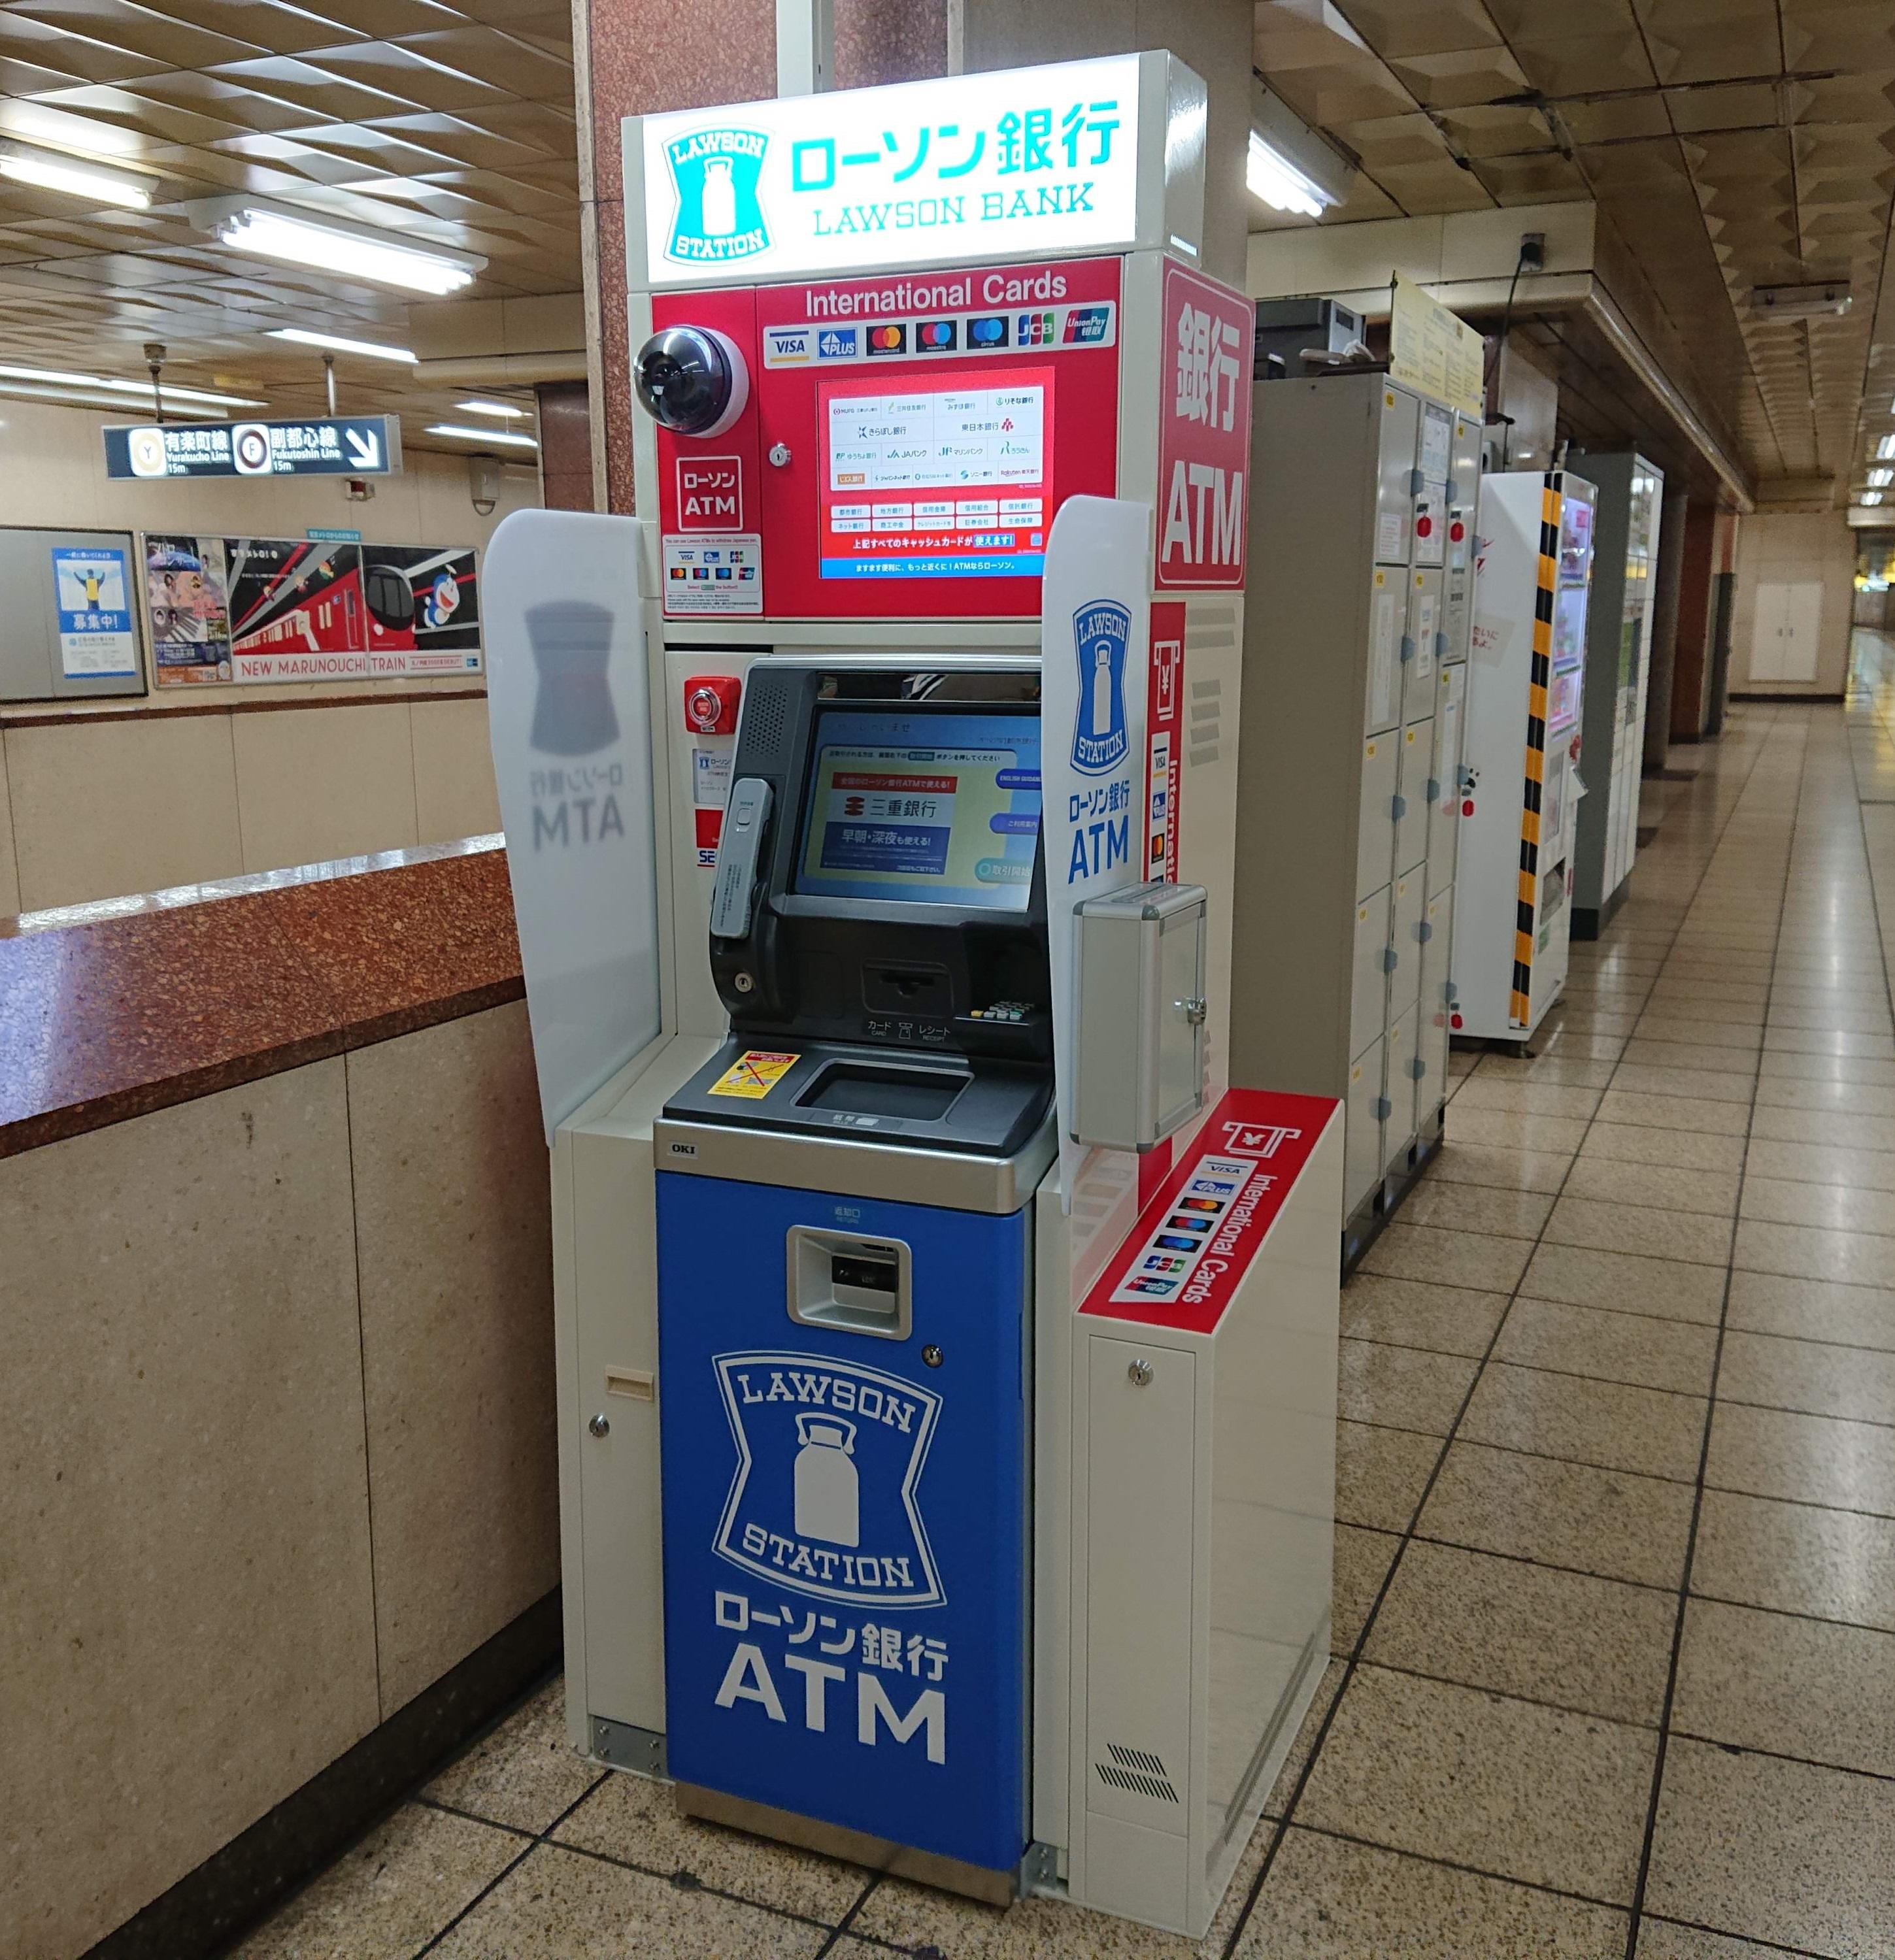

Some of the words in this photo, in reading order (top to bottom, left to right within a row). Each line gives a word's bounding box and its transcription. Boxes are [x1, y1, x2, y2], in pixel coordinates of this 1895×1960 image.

[671, 131, 765, 165] LAWSON
[792, 100, 1120, 192] ローソン銀行
[814, 195, 964, 237] LAWSON
[981, 182, 1094, 221] BANK
[675, 227, 765, 259] STATION
[806, 283, 972, 318] International
[983, 271, 1067, 301] Cards
[1020, 322, 1054, 337] JCB
[1067, 316, 1106, 328] UnionPay
[774, 339, 805, 354] VISA
[829, 341, 856, 356] PLUS
[1176, 302, 1240, 431] 銀行
[1005, 397, 1033, 405] りそな銀行
[869, 426, 907, 436] きらぼし銀行
[962, 422, 999, 431] 東日本銀行
[165, 431, 229, 452] 有楽町線
[271, 427, 337, 449] 副都心線
[144, 446, 152, 459] Y
[167, 452, 210, 463] Yurakucho
[211, 450, 229, 461] Line
[272, 449, 320, 460] Fukutoshin
[321, 448, 341, 459] Line
[901, 450, 927, 458] JAバンク
[167, 463, 186, 474] 15m
[274, 462, 292, 472] 15m
[684, 472, 735, 489] ローソン
[685, 496, 735, 515] ATM
[1161, 459, 1243, 566] ATM
[852, 535, 973, 549] 上記すべてのキャッシュカードが
[1079, 612, 1126, 645] LAWSON
[241, 659, 273, 677] NEW
[278, 656, 366, 674] MARUNOUCHI
[371, 656, 406, 672] TRAIN
[1078, 729, 1123, 765] STATION
[936, 754, 1001, 762] ボタンを押してください
[1155, 756, 1166, 770] VISA
[870, 798, 937, 818] 三重銀行
[1069, 779, 1130, 823] ローソン銀行
[1067, 815, 1129, 885] ATM
[992, 863, 1031, 877] 取引開始
[867, 1020, 892, 1031] カード
[918, 1025, 950, 1037] レシート
[671, 1144, 696, 1154] OKI
[1210, 1165, 1241, 1174] VISA
[1205, 1185, 1231, 1195] PLUS
[835, 1206, 861, 1218] 返却口
[1209, 1174, 1278, 1257] International
[1182, 1259, 1229, 1304] Cards
[737, 1371, 916, 1434] LAWSON
[742, 1522, 914, 1588] STATION
[715, 1589, 949, 1682] ローソン銀行
[714, 1641, 946, 1766] ATM
